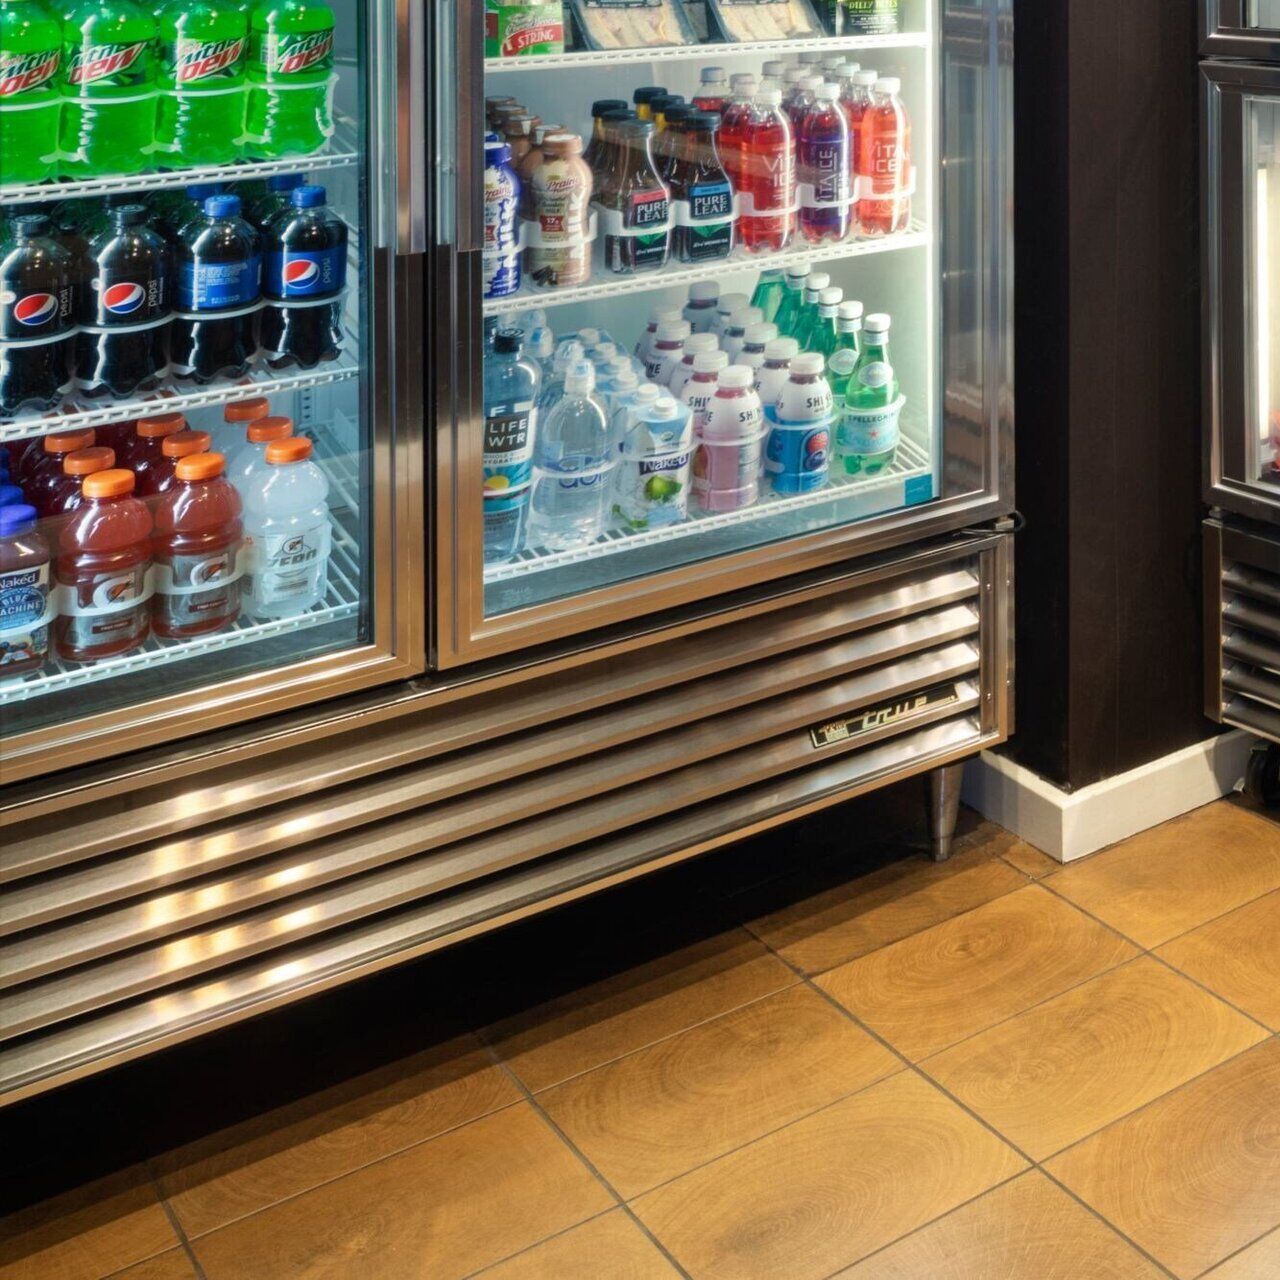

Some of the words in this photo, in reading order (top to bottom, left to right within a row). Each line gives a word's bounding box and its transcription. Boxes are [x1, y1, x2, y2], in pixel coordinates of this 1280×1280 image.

[518, 32, 554, 49] STRING
[694, 195, 728, 207] PURE
[694, 204, 728, 216] LEAF
[321, 258, 332, 284] pepsi
[59, 287, 69, 317] pepsi
[148, 279, 158, 309] pepsi
[489, 418, 528, 434] LIFE
[488, 434, 526, 447] WTR
[0, 601, 41, 617] ACHINE
